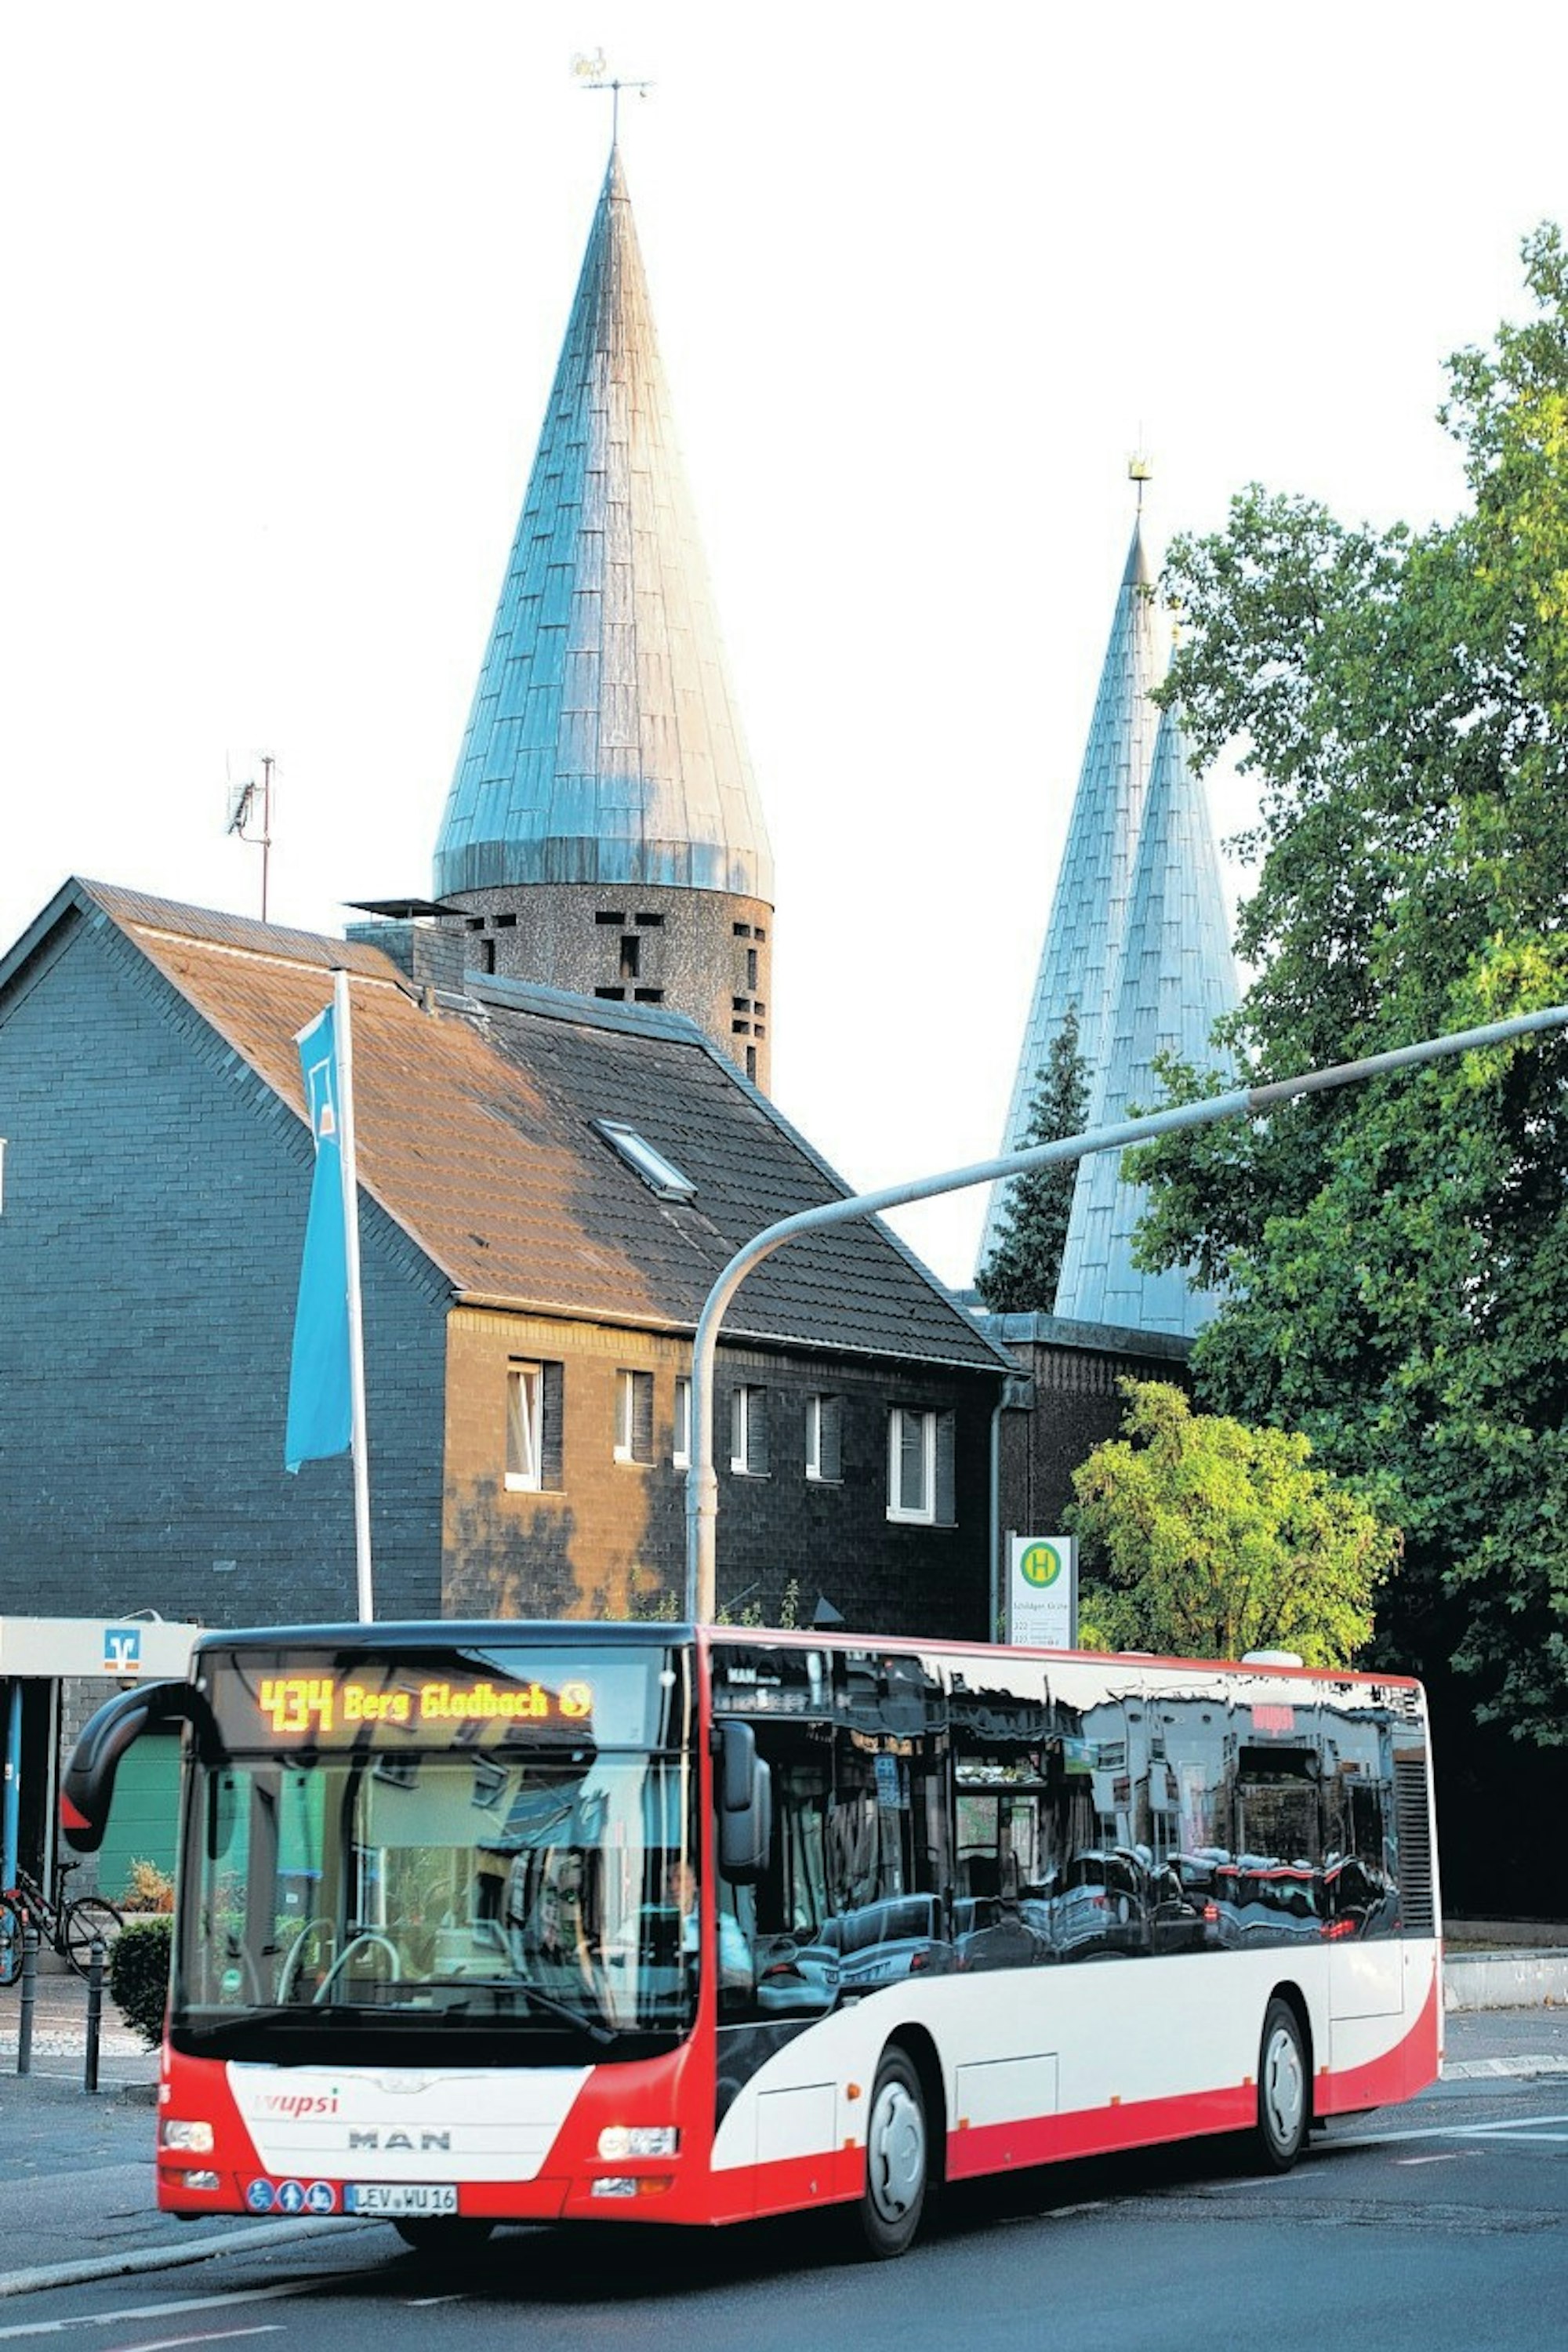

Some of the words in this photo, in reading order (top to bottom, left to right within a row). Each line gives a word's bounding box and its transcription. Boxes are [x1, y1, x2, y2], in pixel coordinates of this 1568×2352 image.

[1033, 1553, 1048, 1578] H
[260, 1679, 333, 1732] 434
[343, 1685, 410, 1720] Berg
[420, 1682, 548, 1718] Gladbach
[349, 2130, 450, 2150] MAN
